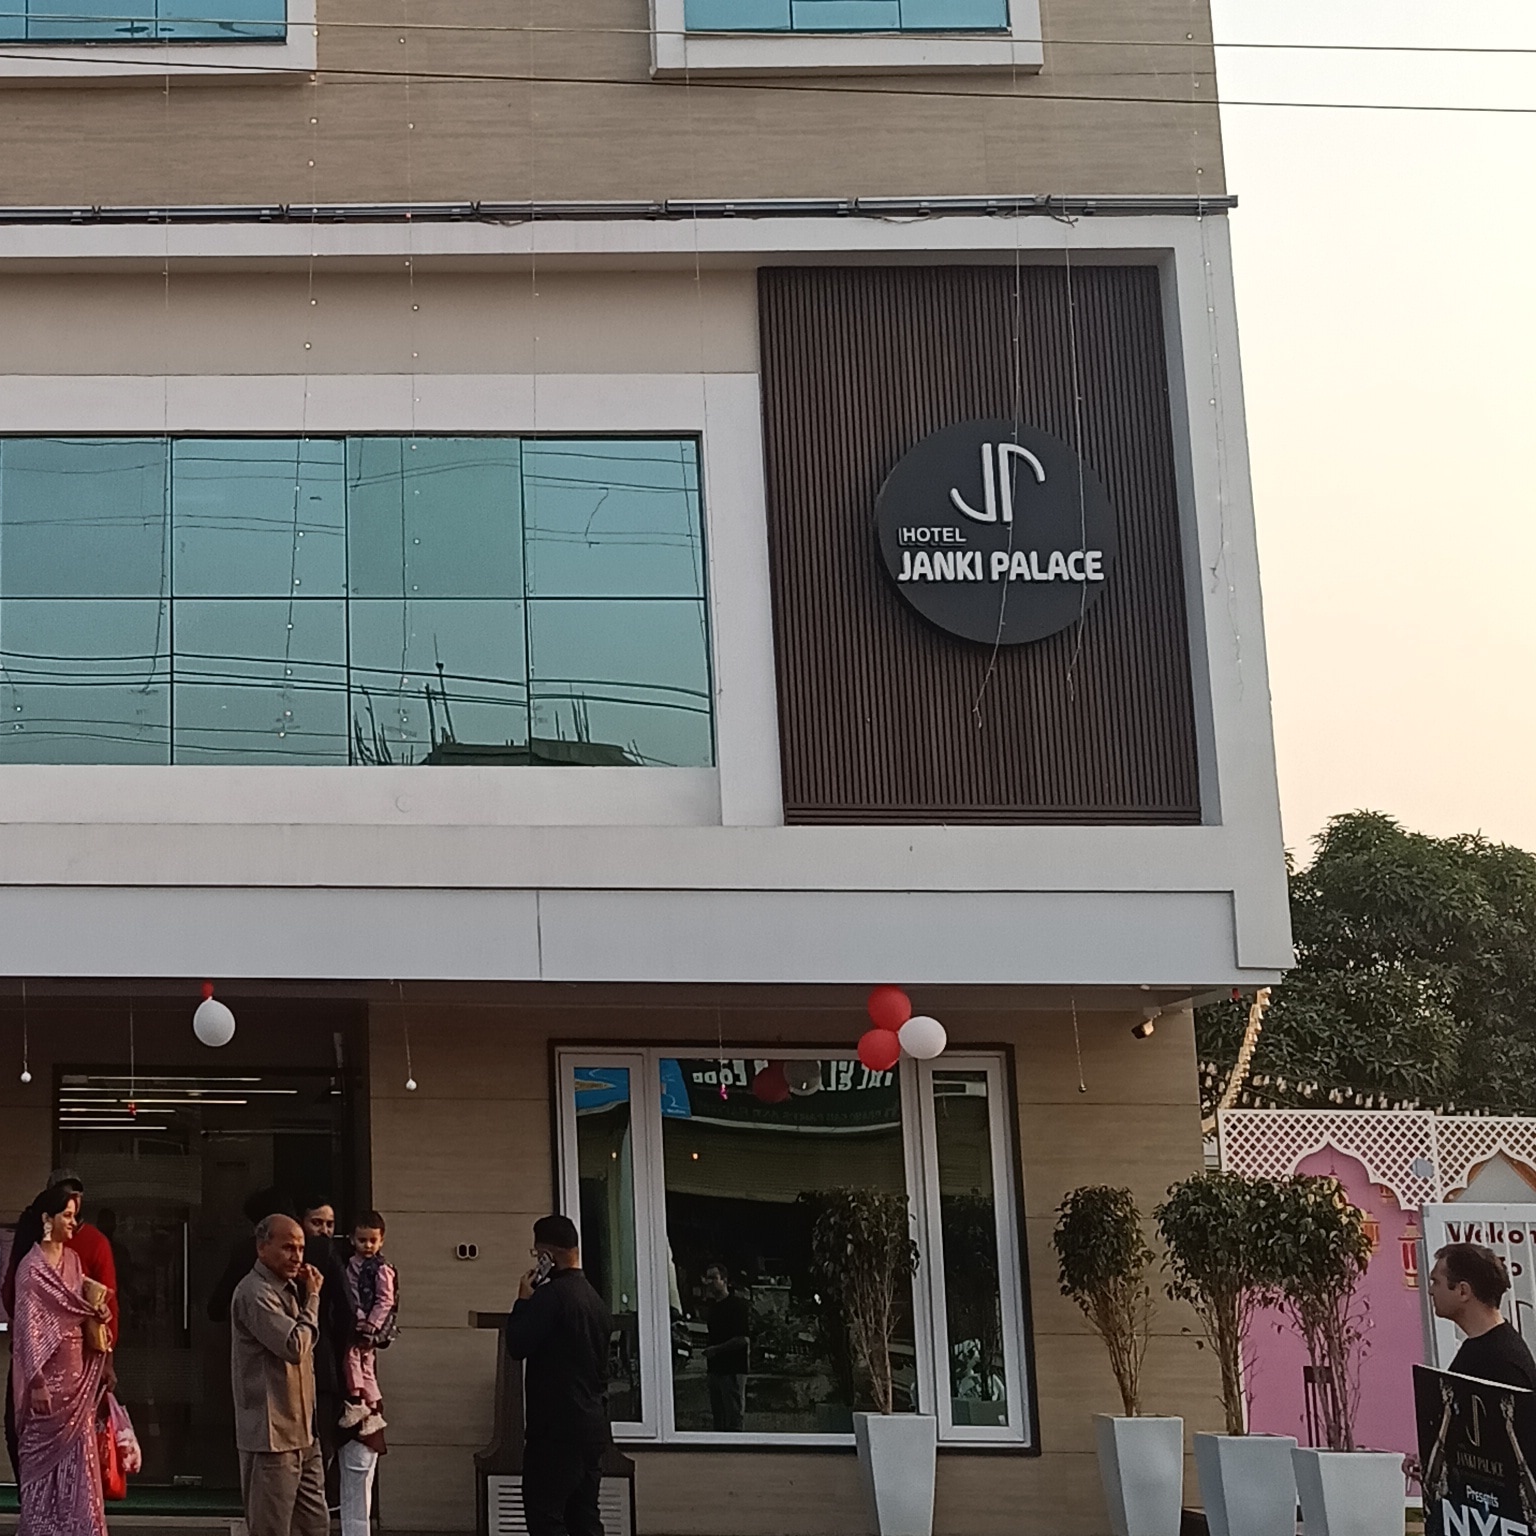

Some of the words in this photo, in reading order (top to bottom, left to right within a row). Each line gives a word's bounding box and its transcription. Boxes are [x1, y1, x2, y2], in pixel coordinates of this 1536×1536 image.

[899, 527, 966, 543] HOTEL
[898, 550, 984, 581] JANKI
[990, 550, 1105, 581] PALACE
